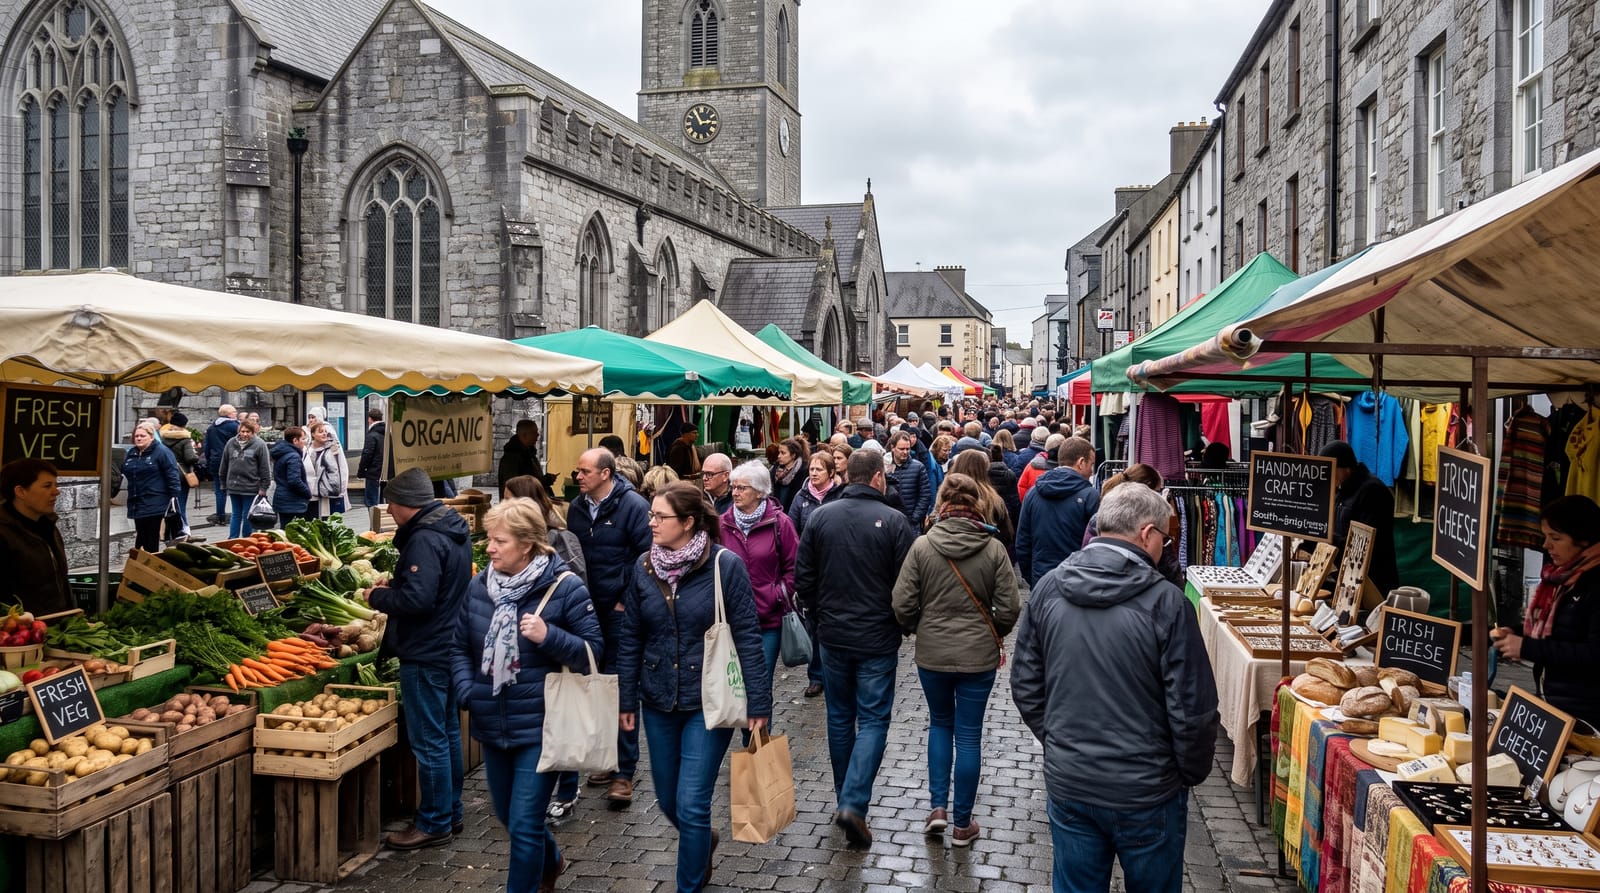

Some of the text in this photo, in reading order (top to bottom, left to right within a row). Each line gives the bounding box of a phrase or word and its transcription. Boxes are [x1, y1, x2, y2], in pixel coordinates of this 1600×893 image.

[14, 397, 92, 428] FRESH
[19, 432, 80, 463] VEG
[401, 416, 484, 448] ORGANIC
[1256, 460, 1329, 481] HANDMADE
[1441, 462, 1478, 504] IRISH
[1264, 478, 1313, 498] CRAFTS
[1437, 504, 1477, 550] CHEESE
[1391, 616, 1435, 641] IRISH
[1385, 635, 1445, 664] CHEESE
[36, 675, 88, 708] FRESH
[52, 700, 90, 727] VEG
[1510, 701, 1547, 740] IRISH
[1498, 725, 1548, 772] CHEESE
